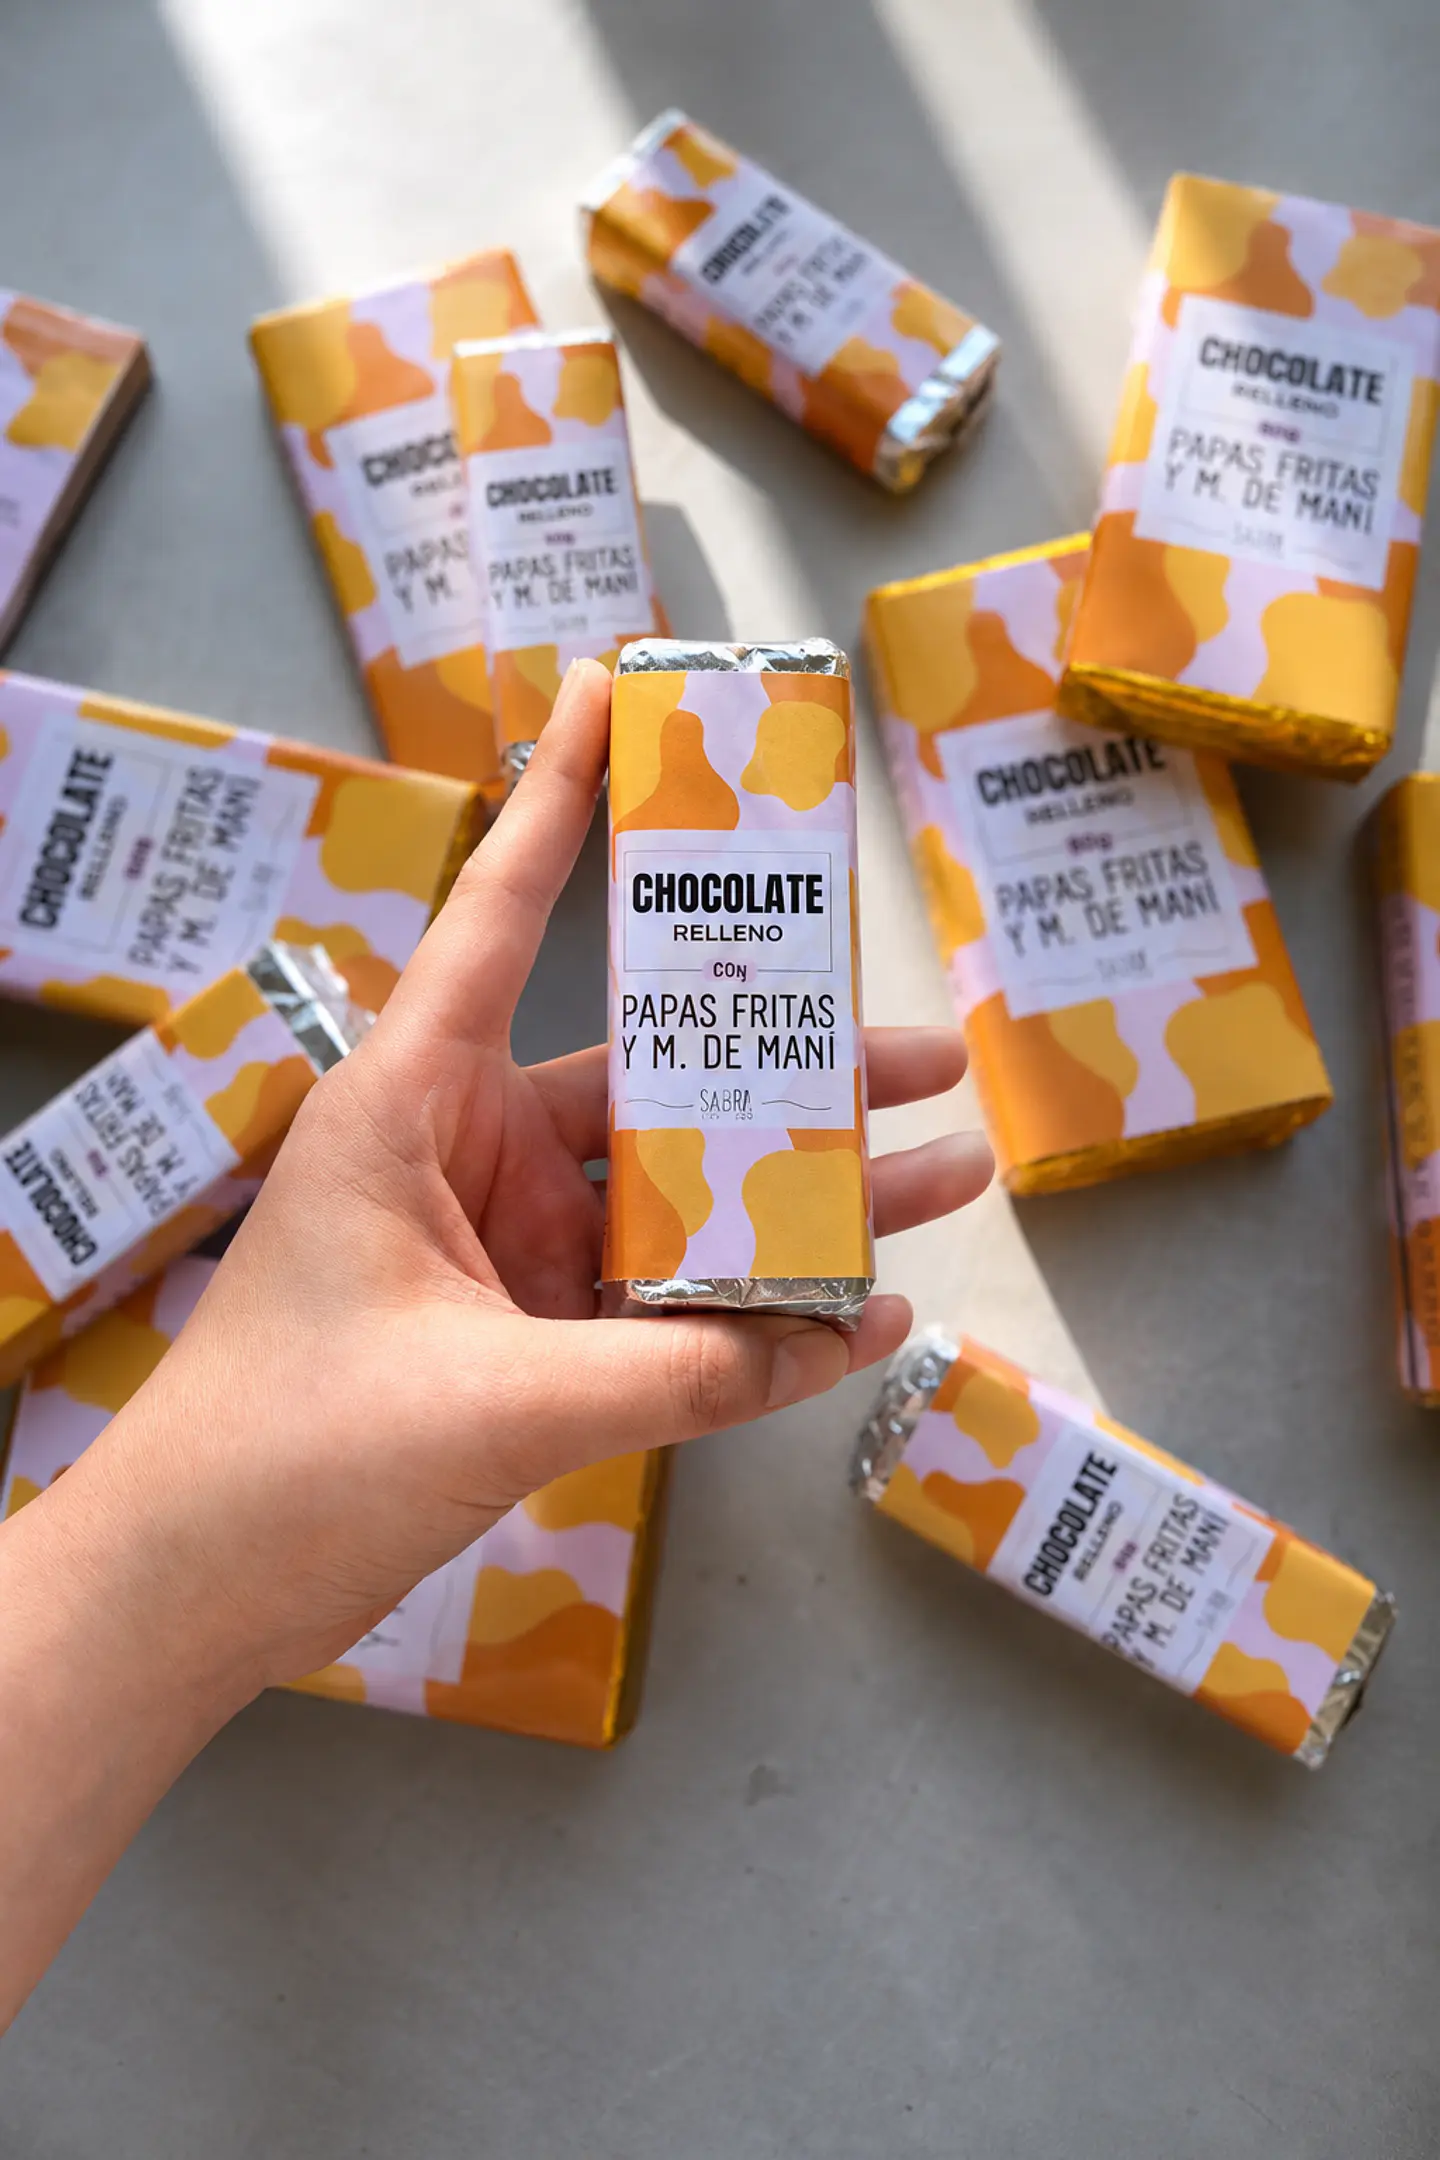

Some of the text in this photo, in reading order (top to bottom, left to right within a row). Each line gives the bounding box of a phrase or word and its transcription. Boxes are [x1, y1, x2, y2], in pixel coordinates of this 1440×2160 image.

[1199, 337, 1384, 405] CHOCOLATE
[486, 467, 617, 508] CHOCOLATE
[1164, 462, 1182, 492] Y
[1242, 477, 1283, 514] DE
[1169, 427, 1265, 477] PAPAS
[1276, 450, 1380, 500] FRITAS
[976, 738, 1166, 808] CHOCOLATE
[18, 746, 114, 930] CHOCOLATE
[632, 873, 824, 914] CHOCOLATE
[995, 866, 1094, 917] PAPAS
[1101, 840, 1209, 894] FRITAS
[673, 925, 783, 942] RELLENO
[1004, 922, 1025, 958] Y
[1084, 900, 1129, 939] DE
[713, 962, 747, 982] CON
[622, 993, 835, 1029] PAPAS FRITAS
[622, 1031, 835, 1070] Y M. DE MANÍ
[700, 1088, 752, 1112] SABRA
[1022, 1451, 1118, 1597] CHOCOLATE
[1102, 1576, 1158, 1651] PAPAS
[1142, 1493, 1200, 1576] FRITAS
[1159, 1574, 1195, 1614] DE
